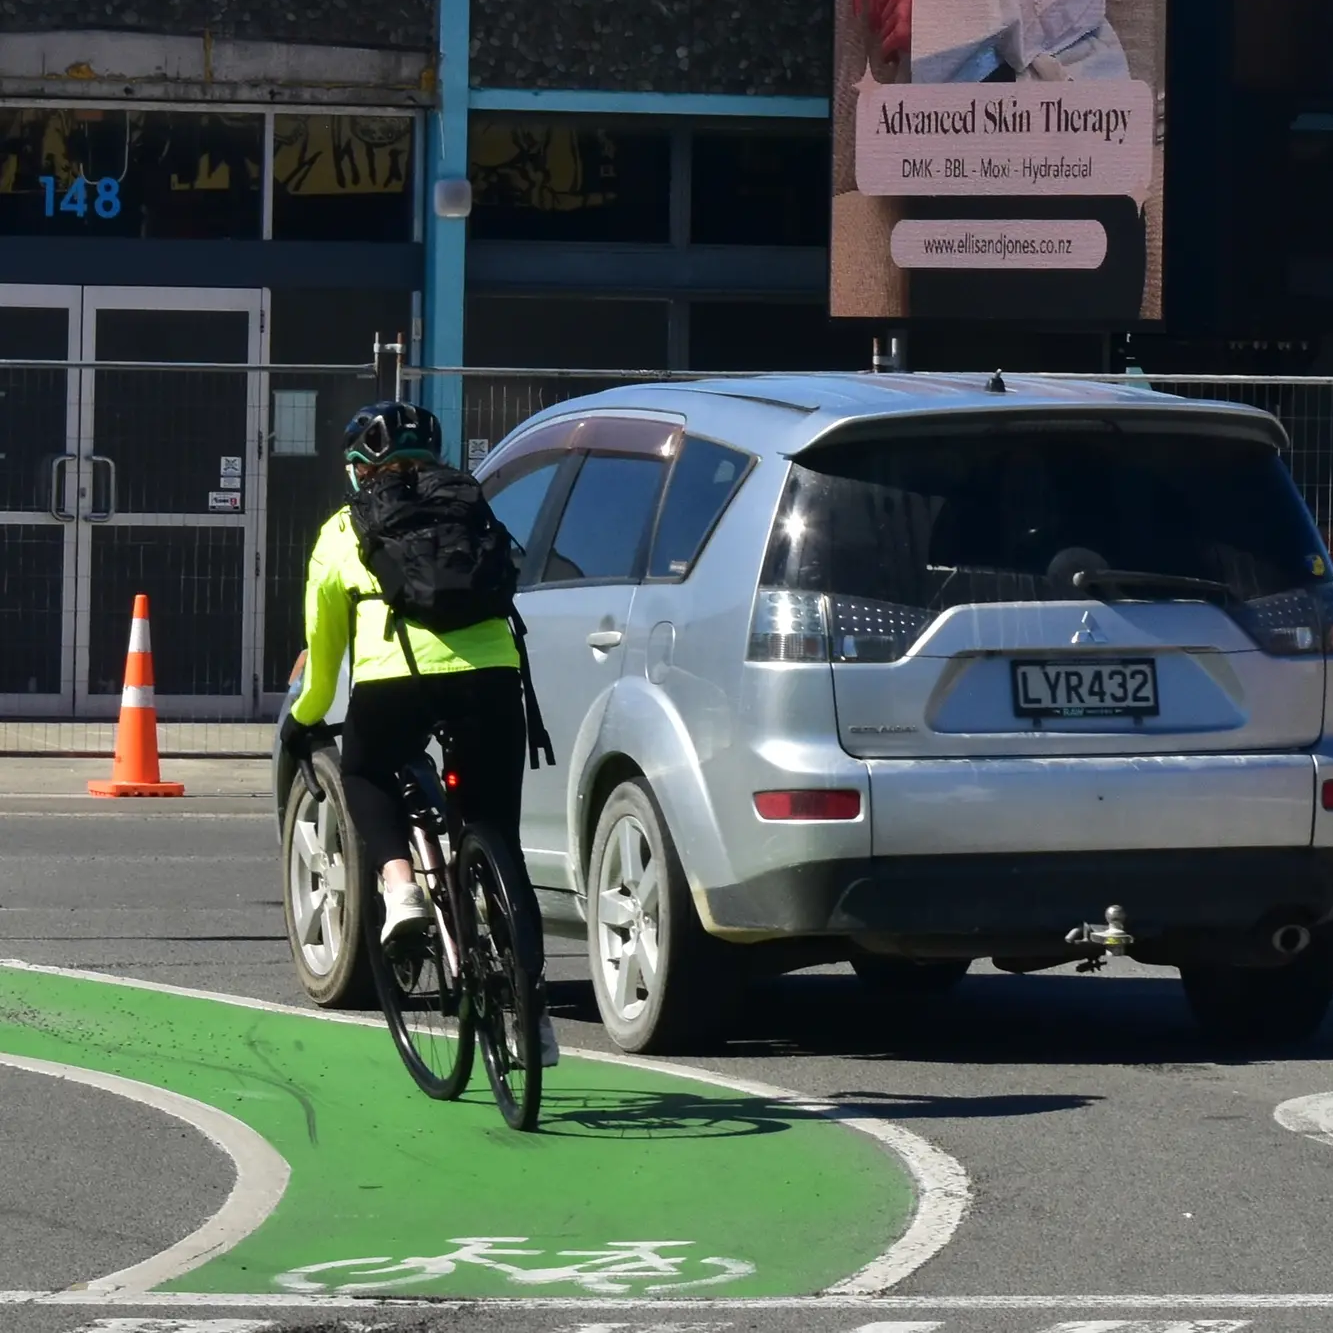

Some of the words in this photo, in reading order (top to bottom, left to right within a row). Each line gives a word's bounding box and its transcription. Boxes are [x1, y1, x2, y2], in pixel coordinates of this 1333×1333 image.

[876, 98, 976, 135] Advanced
[983, 96, 1032, 135] Skin
[1040, 97, 1132, 143] Therapy
[902, 158, 933, 178] DMK
[944, 158, 968, 178] BBL
[980, 158, 1011, 178] Moxi
[1022, 156, 1092, 184] Hydrafacial
[39, 176, 121, 219] 148
[924, 232, 1073, 259] www.ellisandjones.co.nz
[1021, 669, 1151, 705] LYR432
